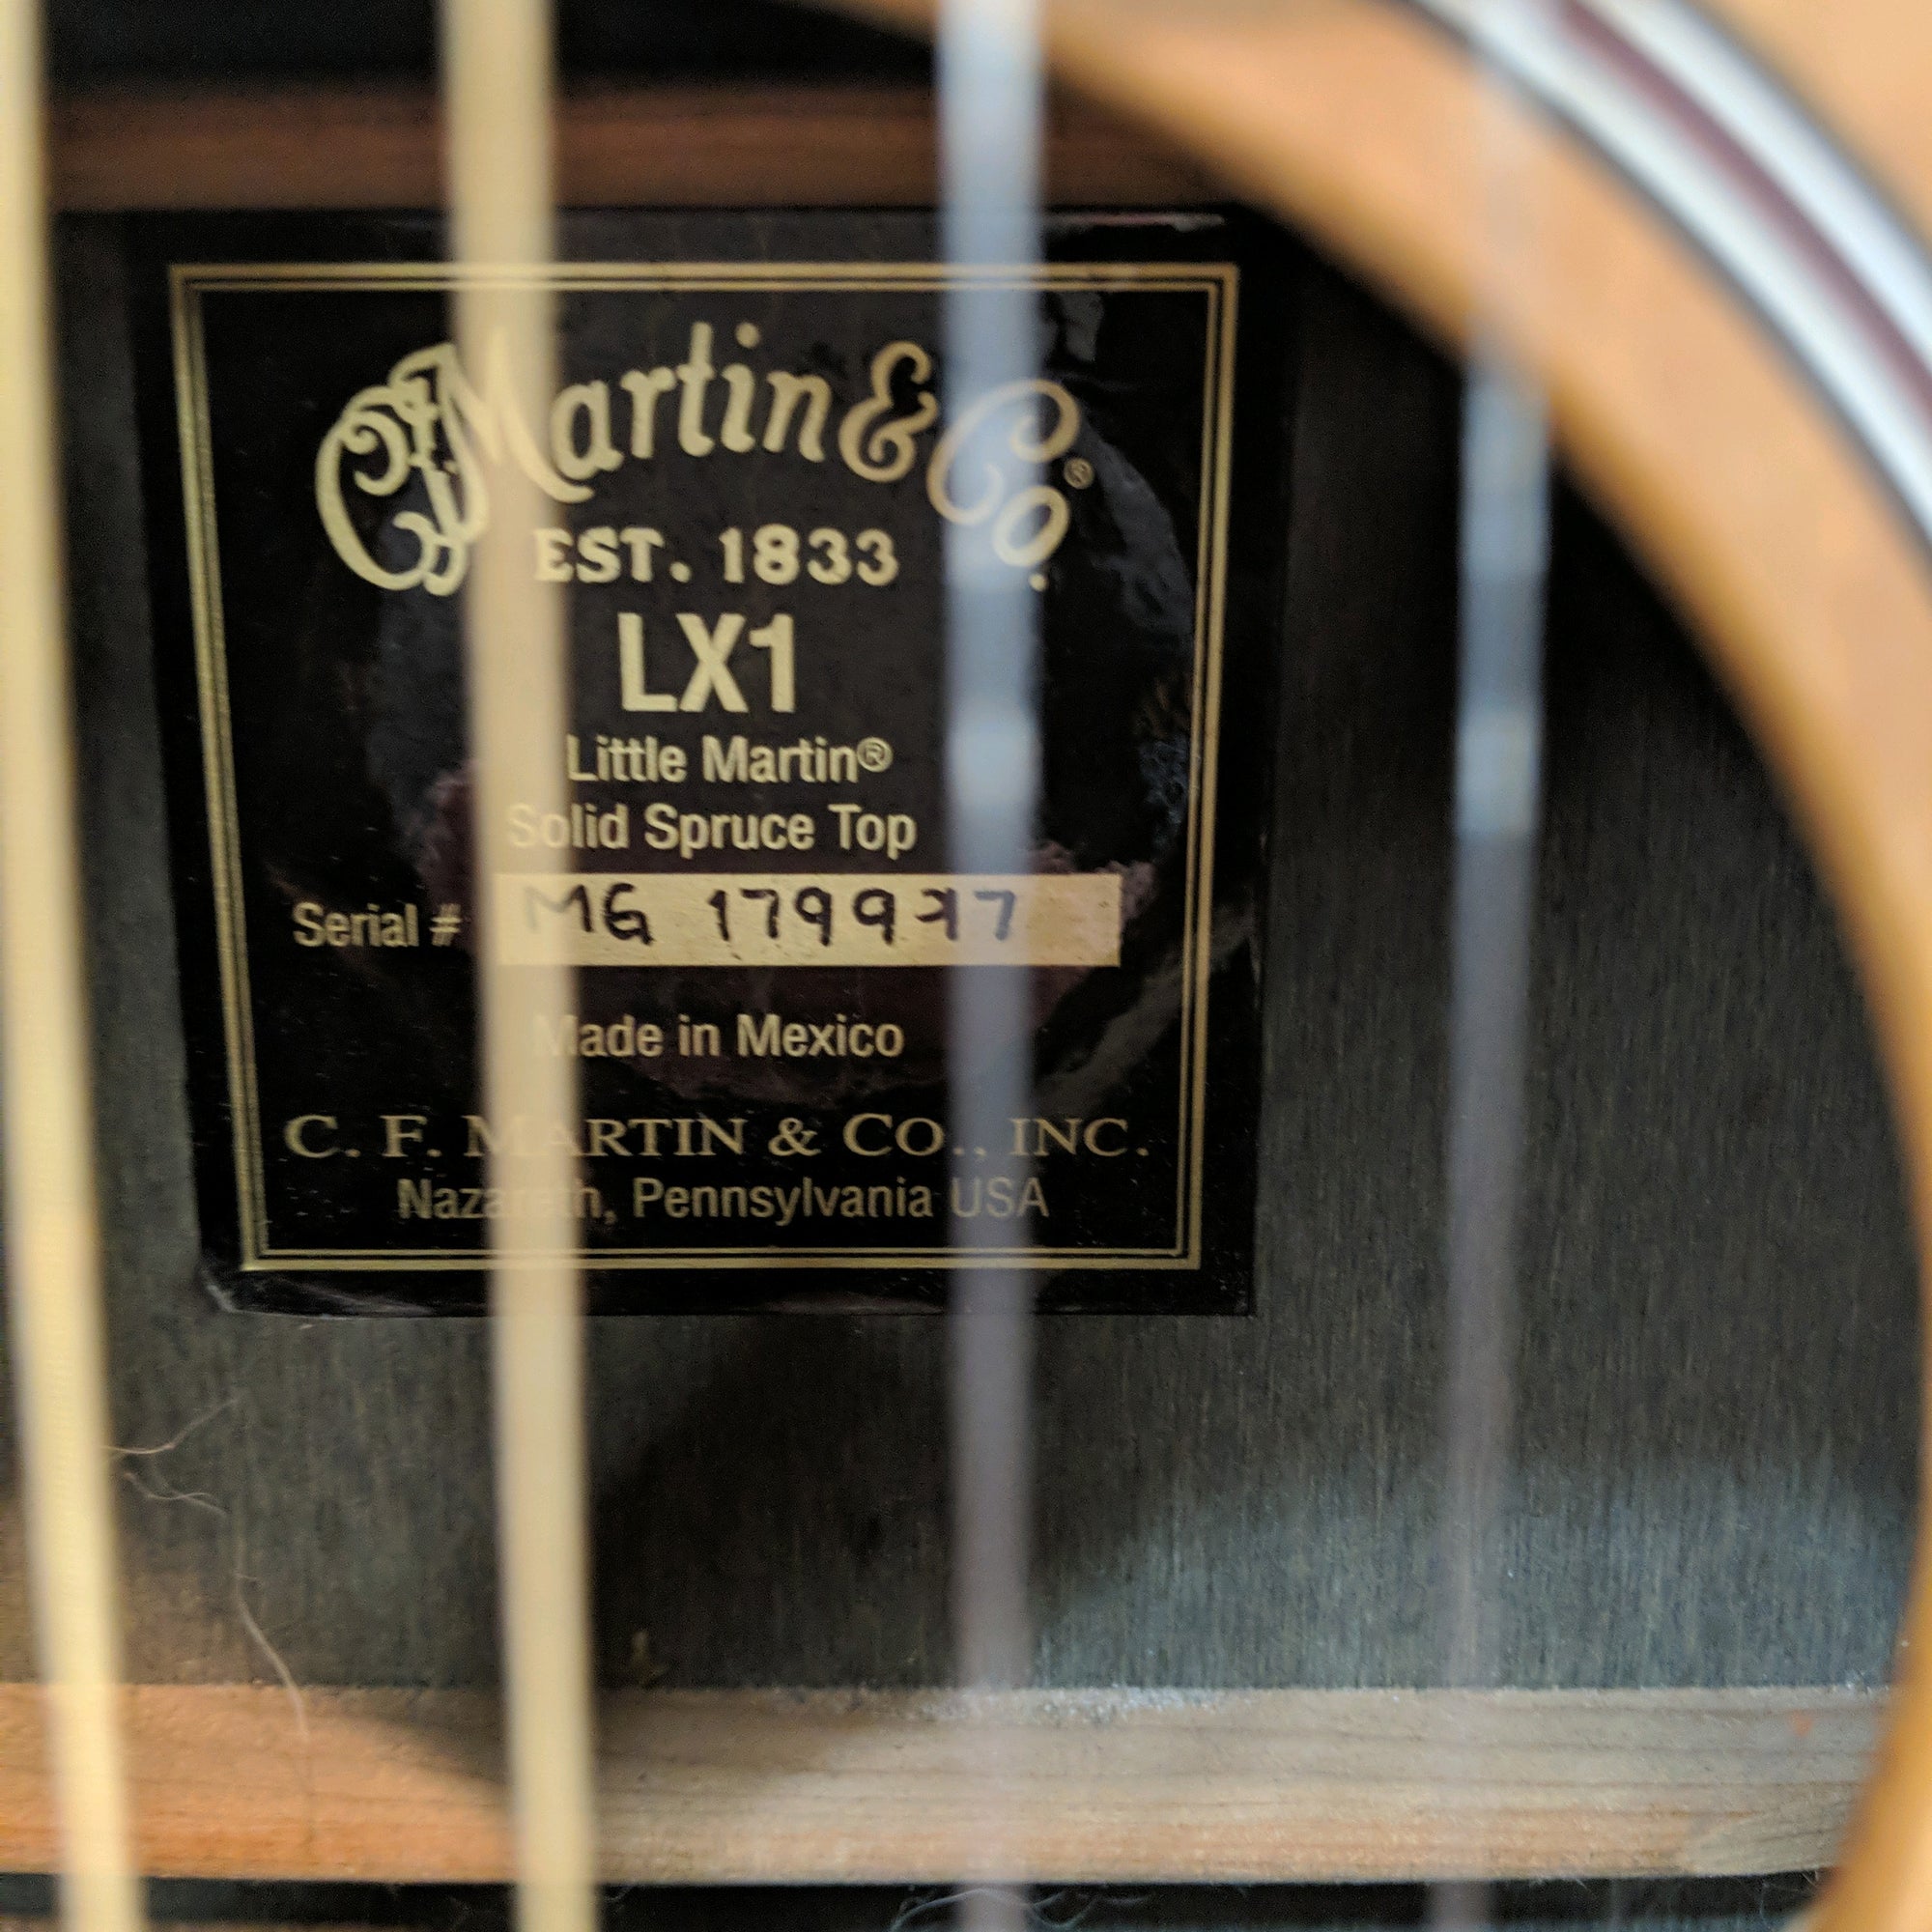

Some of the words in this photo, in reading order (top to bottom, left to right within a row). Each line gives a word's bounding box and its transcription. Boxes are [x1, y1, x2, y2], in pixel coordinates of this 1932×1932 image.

[533, 526, 692, 582] EST.
[719, 524, 899, 586] 1833
[617, 611, 796, 713] LX1
[566, 734, 687, 782] Little
[507, 802, 630, 850] Solid
[644, 802, 815, 860] Spruce
[828, 803, 918, 861] Top
[293, 900, 420, 949] Serial
[430, 902, 462, 947] #
[524, 882, 654, 946] MG
[530, 1012, 665, 1059] Made
[677, 1014, 721, 1057] in
[736, 1013, 904, 1058] Mexico
[283, 1114, 361, 1158] C.
[380, 1115, 441, 1157] F.
[461, 1114, 747, 1157] MARTIN
[767, 1117, 821, 1156] &
[1009, 1118, 1150, 1157] INC.
[397, 1178, 615, 1224] Nazah,
[633, 1177, 934, 1226] Pennsylvania
[951, 1177, 1050, 1218] USA
